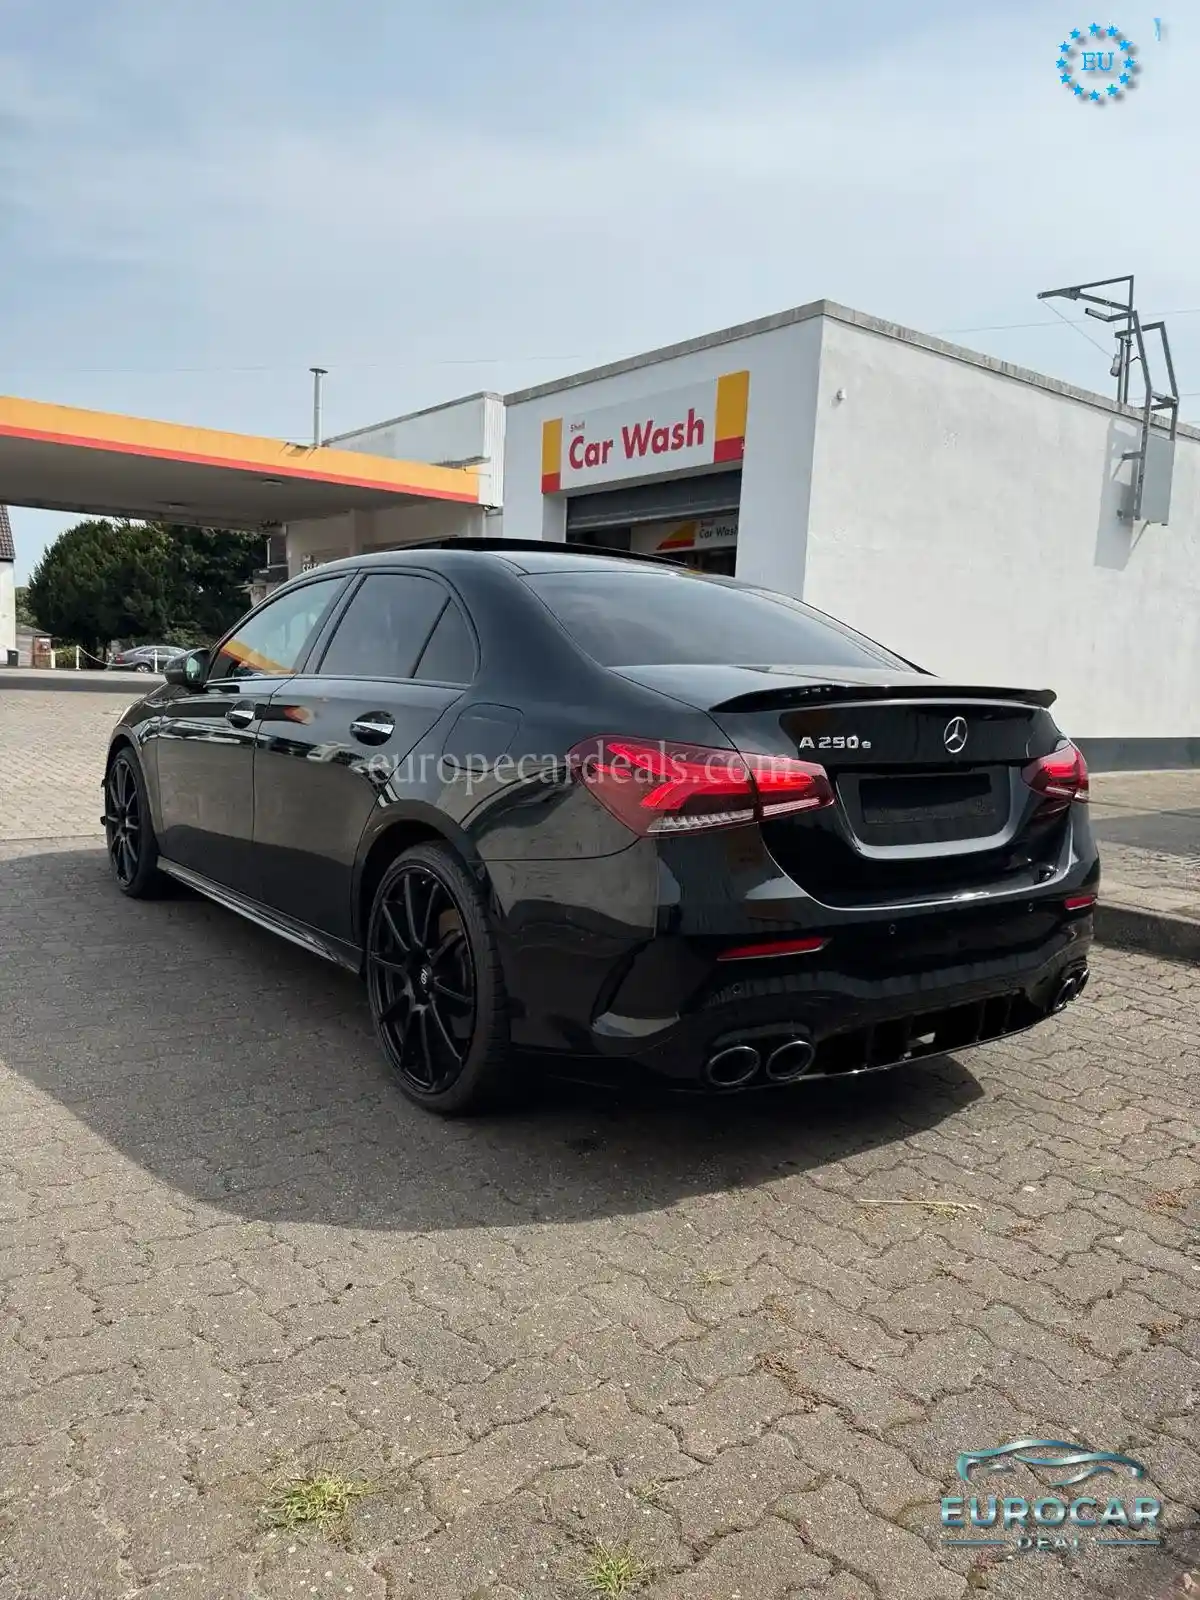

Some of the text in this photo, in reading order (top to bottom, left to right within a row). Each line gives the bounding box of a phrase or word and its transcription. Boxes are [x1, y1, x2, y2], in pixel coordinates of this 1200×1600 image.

[569, 408, 705, 470] Car Wash
[699, 528, 712, 539] Car
[799, 736, 816, 749] A
